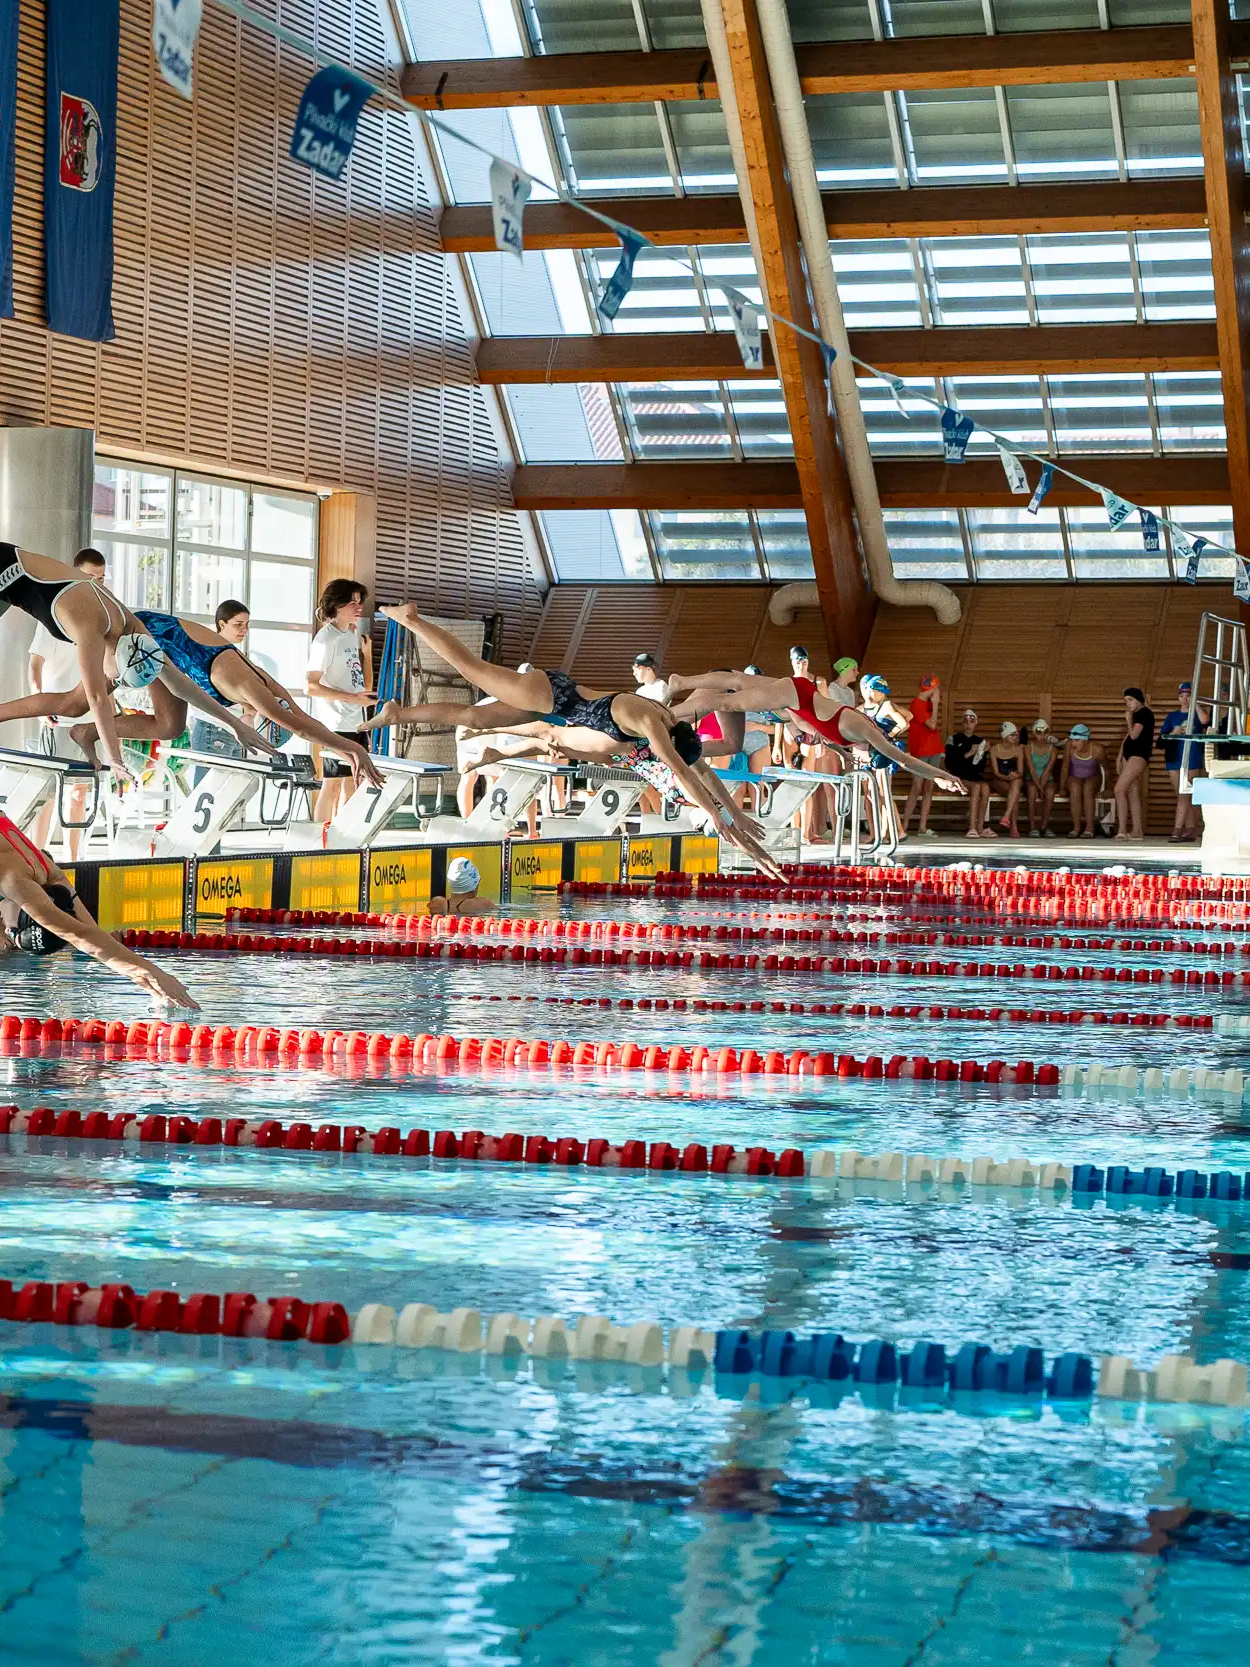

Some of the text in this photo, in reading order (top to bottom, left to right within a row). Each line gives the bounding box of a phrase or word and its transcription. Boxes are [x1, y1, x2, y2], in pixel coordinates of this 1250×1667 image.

[365, 787, 382, 823] 7
[490, 788, 508, 820] 8
[602, 789, 619, 816] 9
[515, 856, 542, 876] OMEGA
[631, 850, 654, 867] OMEGA
[202, 874, 242, 901] OMEGA
[374, 864, 406, 886] OMEGA
